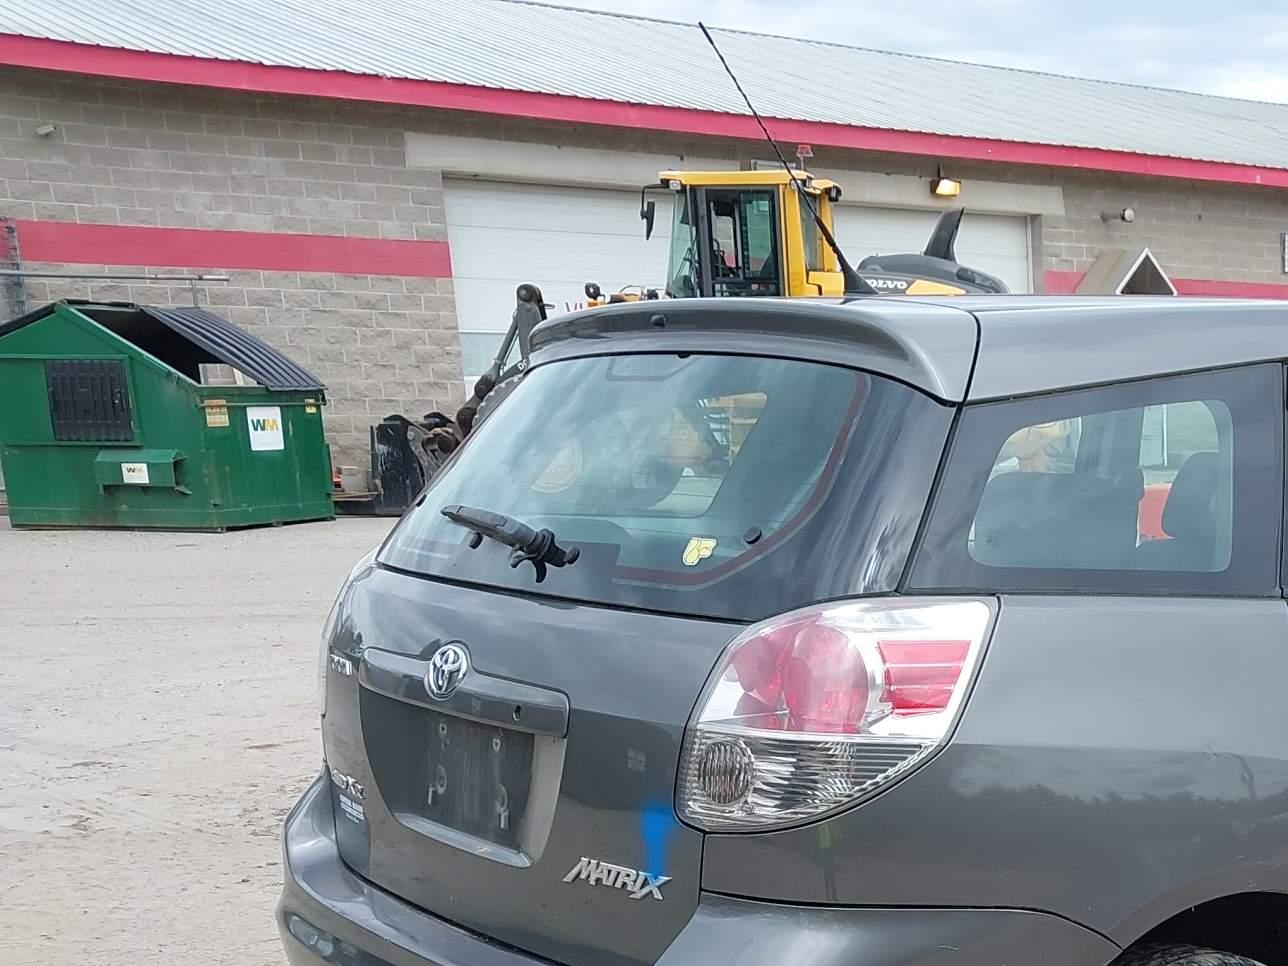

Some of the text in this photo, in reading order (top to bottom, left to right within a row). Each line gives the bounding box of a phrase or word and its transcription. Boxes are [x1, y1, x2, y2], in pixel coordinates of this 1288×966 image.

[864, 279, 908, 289] OLVO
[250, 418, 279, 432] WM
[562, 857, 673, 900] MATRIX
